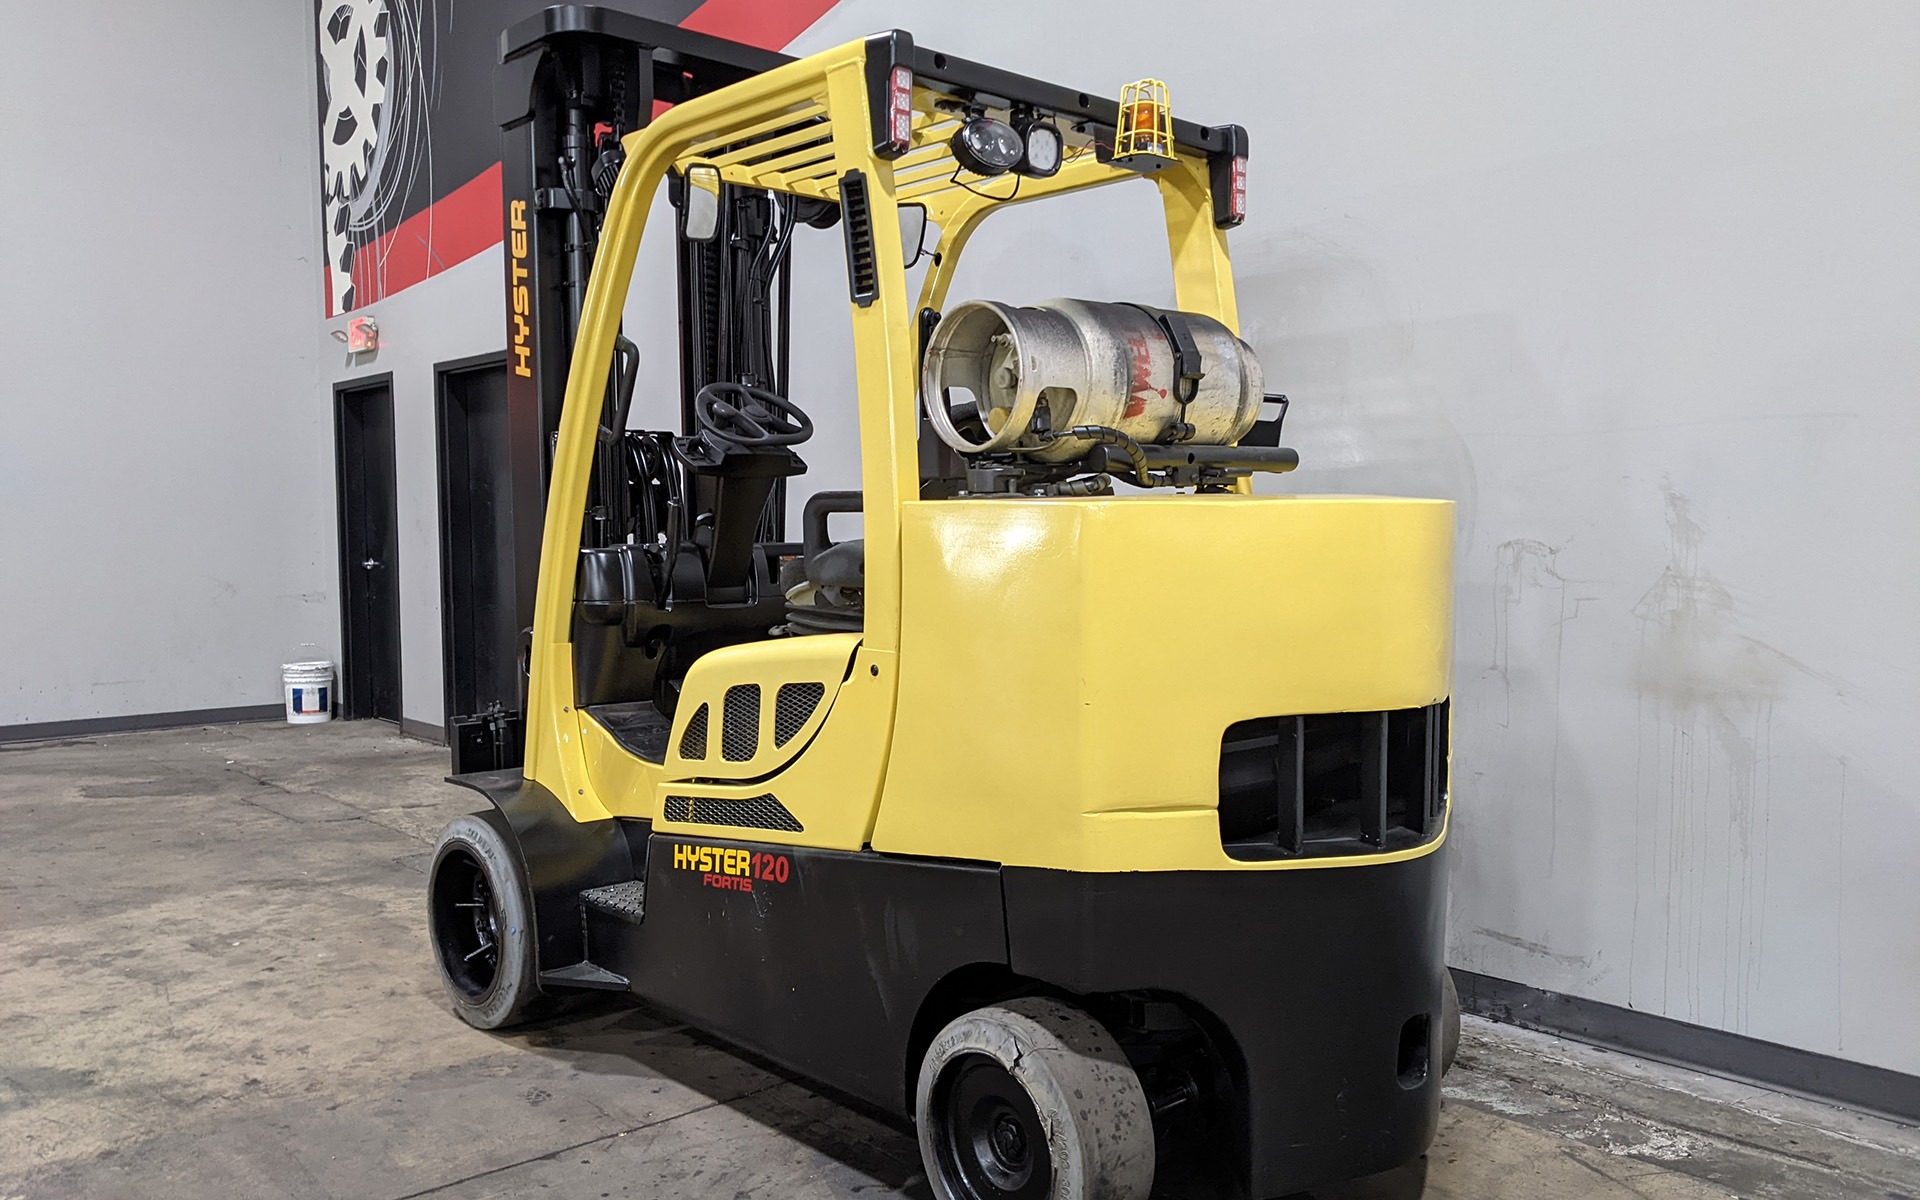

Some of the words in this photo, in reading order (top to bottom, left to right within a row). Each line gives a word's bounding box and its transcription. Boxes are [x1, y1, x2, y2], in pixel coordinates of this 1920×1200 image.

[510, 199, 531, 378] HYSTER
[673, 843, 751, 877] HYSTER
[752, 852, 789, 884] 120
[703, 873, 752, 892] FORTIS
